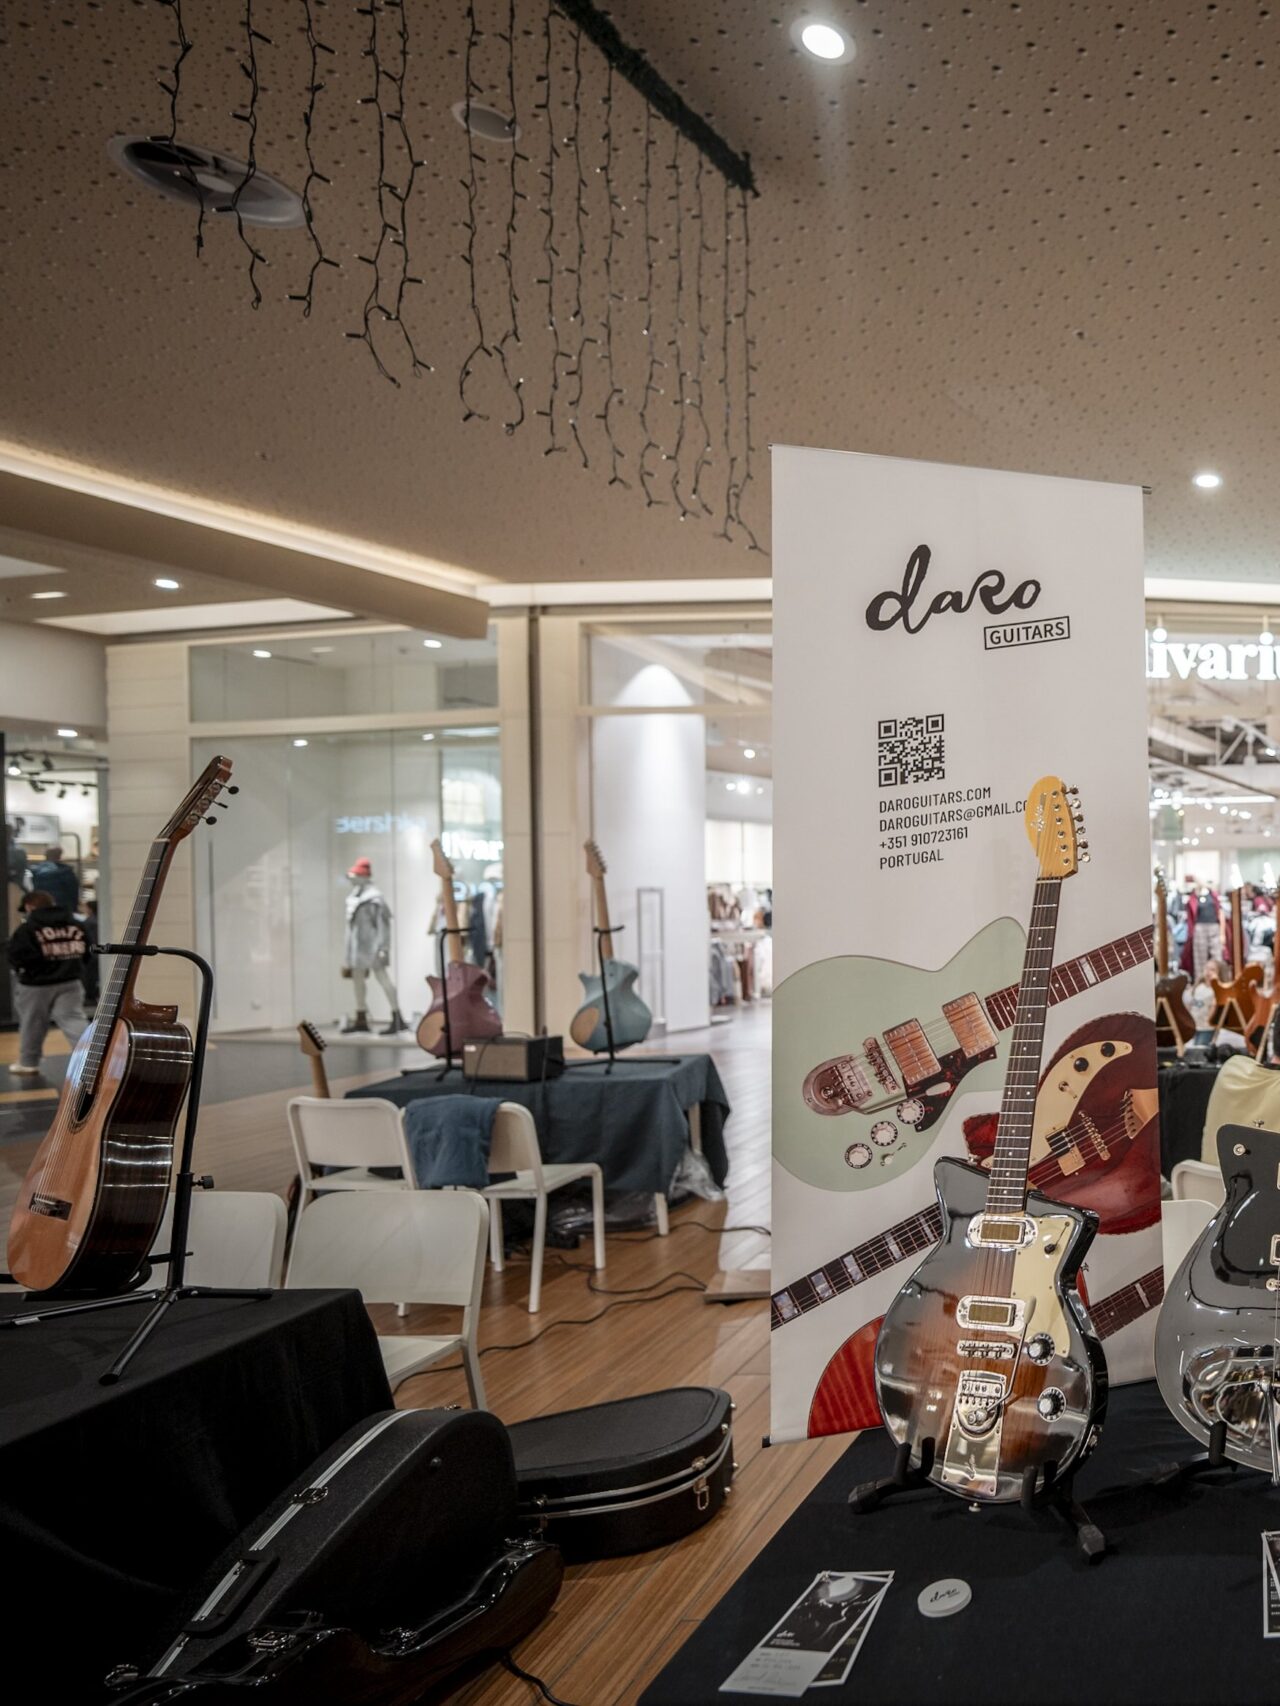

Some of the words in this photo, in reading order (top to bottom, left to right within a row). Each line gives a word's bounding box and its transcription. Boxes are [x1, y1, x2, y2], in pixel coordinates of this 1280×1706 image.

[988, 620, 1066, 646] GUITARS
[879, 786, 992, 813] DAROGUITARS.COM
[879, 835, 907, 850] +351
[911, 826, 968, 847] 910723161
[879, 849, 945, 870] PORTUGAL
